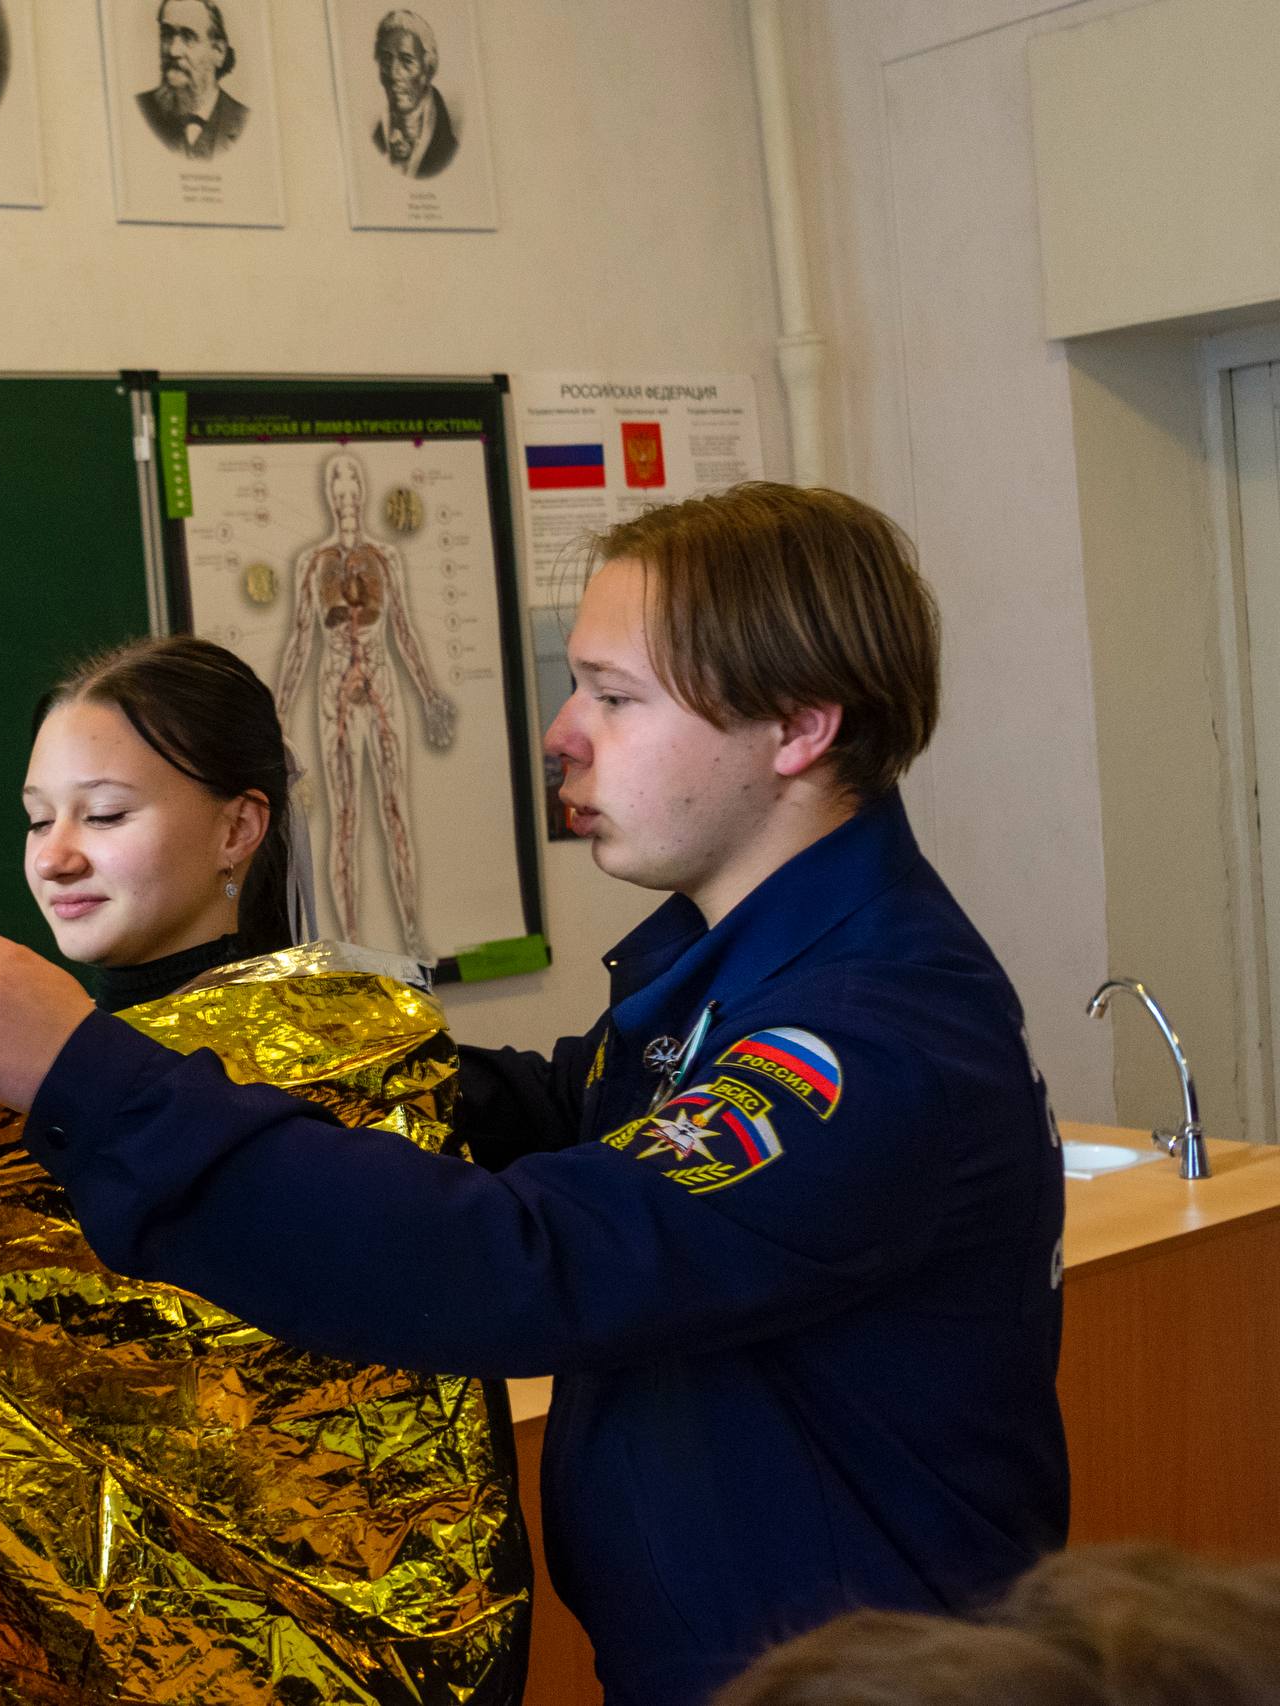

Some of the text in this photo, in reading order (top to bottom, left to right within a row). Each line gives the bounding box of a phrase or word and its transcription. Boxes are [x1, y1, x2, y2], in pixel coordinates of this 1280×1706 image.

[560, 383, 718, 401] РОССИЙСКАЯ ФЕДЕРАЦИЯ
[737, 1054, 814, 1097] РОССИЯ
[715, 1083, 759, 1110] ВСКС
